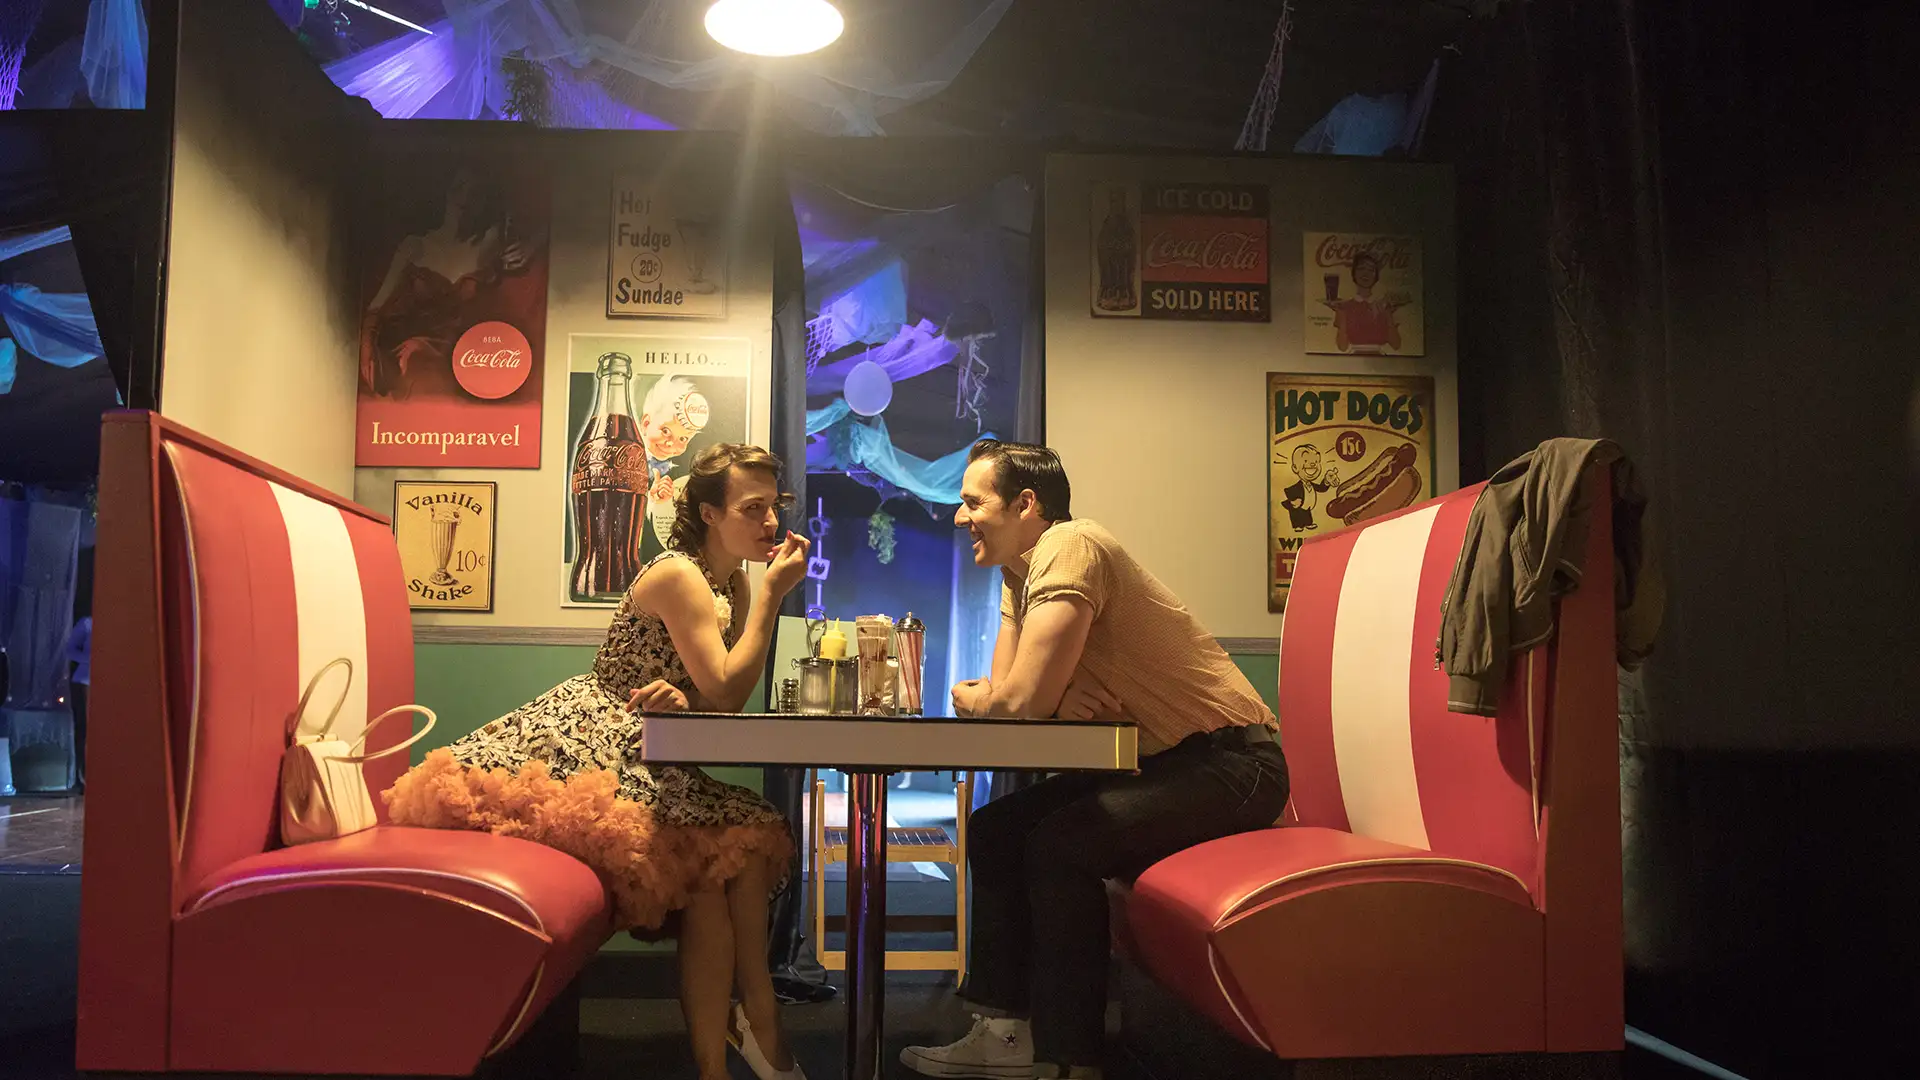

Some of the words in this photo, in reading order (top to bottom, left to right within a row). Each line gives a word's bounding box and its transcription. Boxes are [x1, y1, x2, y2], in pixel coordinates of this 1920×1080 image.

[1157, 188, 1189, 208] ICE
[1198, 190, 1254, 210] COLD
[618, 223, 672, 252] Fudge
[1146, 231, 1263, 270] Coca-Cola
[615, 277, 684, 306] Sundae
[1151, 289, 1203, 310] SOLD
[1208, 291, 1260, 312] HERE
[460, 349, 522, 369] Coca-Cola
[1274, 390, 1341, 435] HOT
[1346, 391, 1424, 436] DOGS
[371, 422, 520, 455] Incomparavel
[405, 492, 483, 516] Vanilla
[408, 579, 473, 601] Shake
